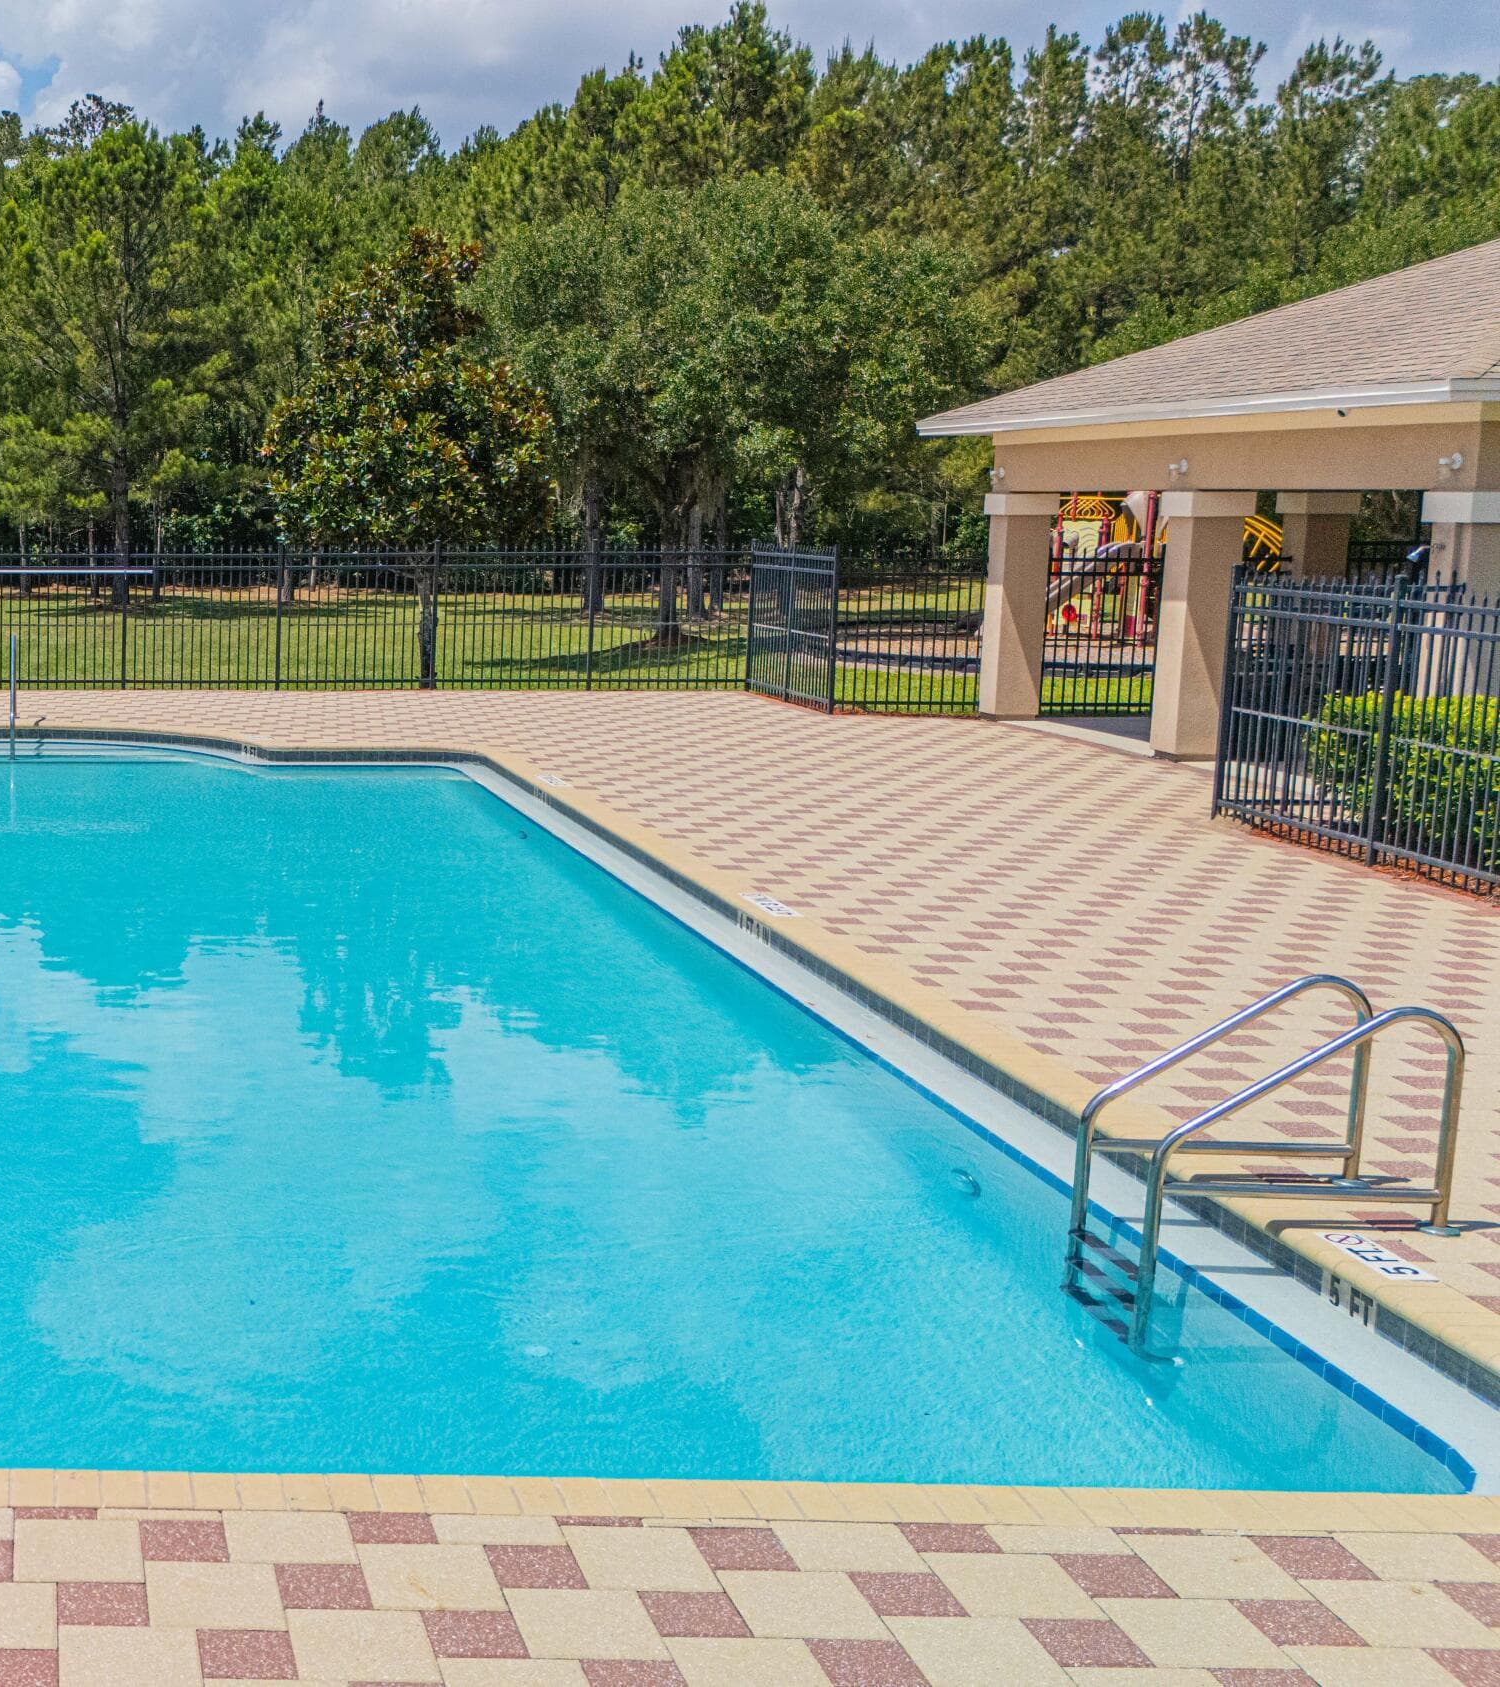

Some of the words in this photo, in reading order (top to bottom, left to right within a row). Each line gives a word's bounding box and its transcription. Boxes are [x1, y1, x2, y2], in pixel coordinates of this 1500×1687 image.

[1380, 1266, 1419, 1275] 5
[1329, 1274, 1341, 1307] 5
[1349, 1286, 1374, 1327] FT
